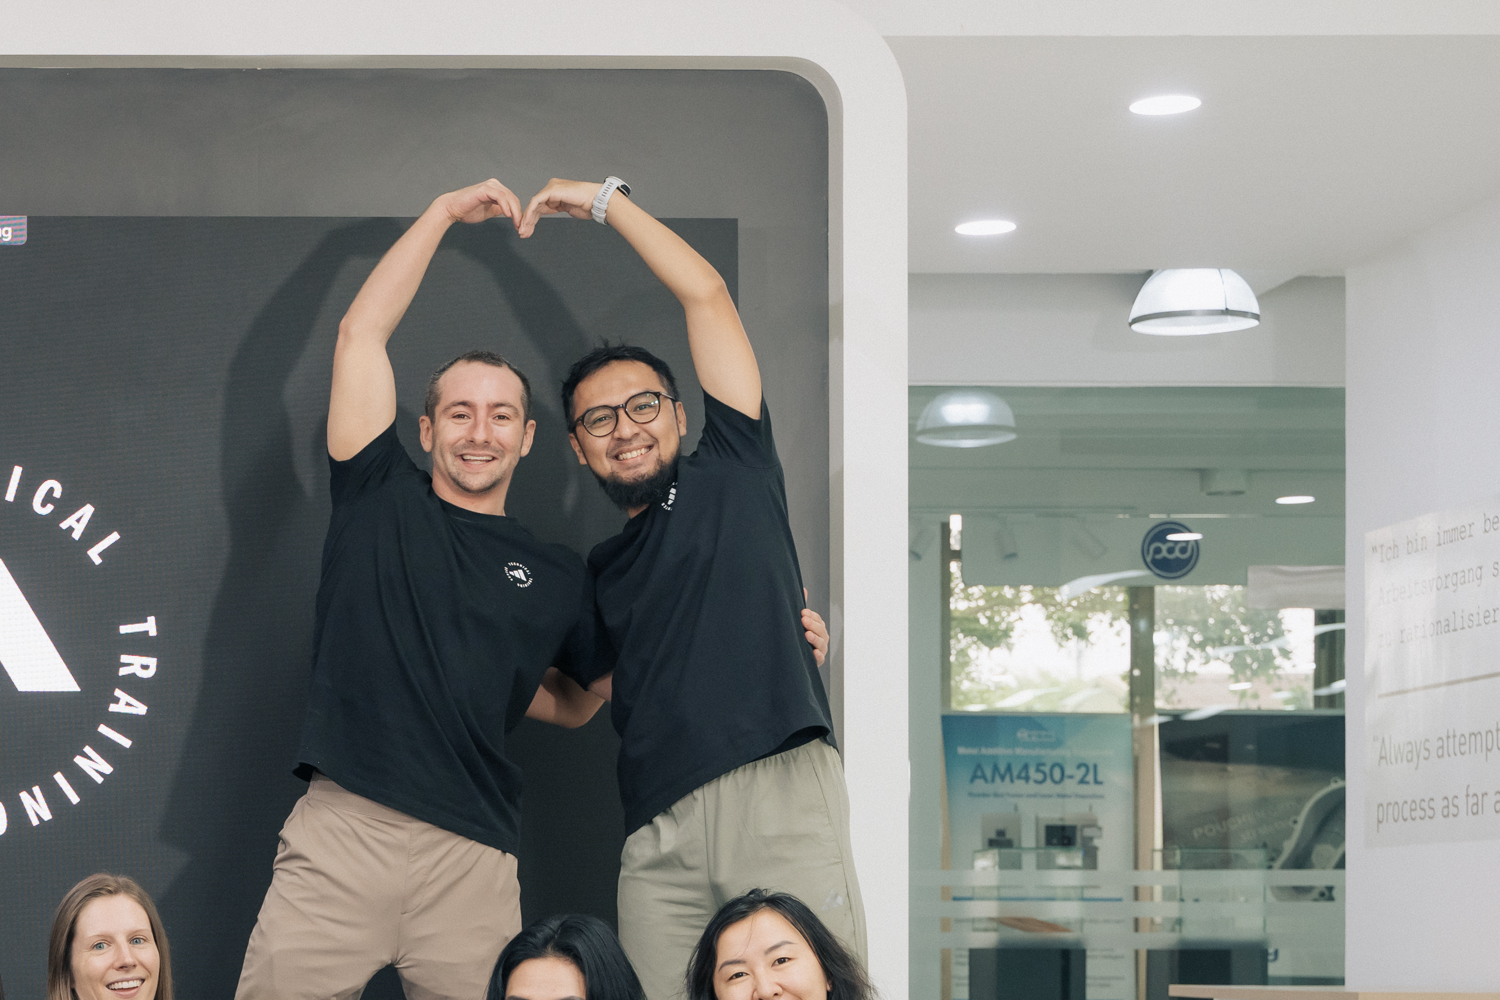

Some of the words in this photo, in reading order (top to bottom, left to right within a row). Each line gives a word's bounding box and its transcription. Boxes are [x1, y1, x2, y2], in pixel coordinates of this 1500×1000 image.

[1406, 532, 1428, 555] bin
[1436, 521, 1475, 547] immer
[1483, 512, 1500, 534] be
[1400, 604, 1500, 644] rationalisier
[1436, 721, 1500, 762] attempt
[969, 762, 1104, 786] AM450-2L
[1376, 797, 1436, 833] process
[1441, 795, 1460, 819] as
[1465, 784, 1488, 817] far
